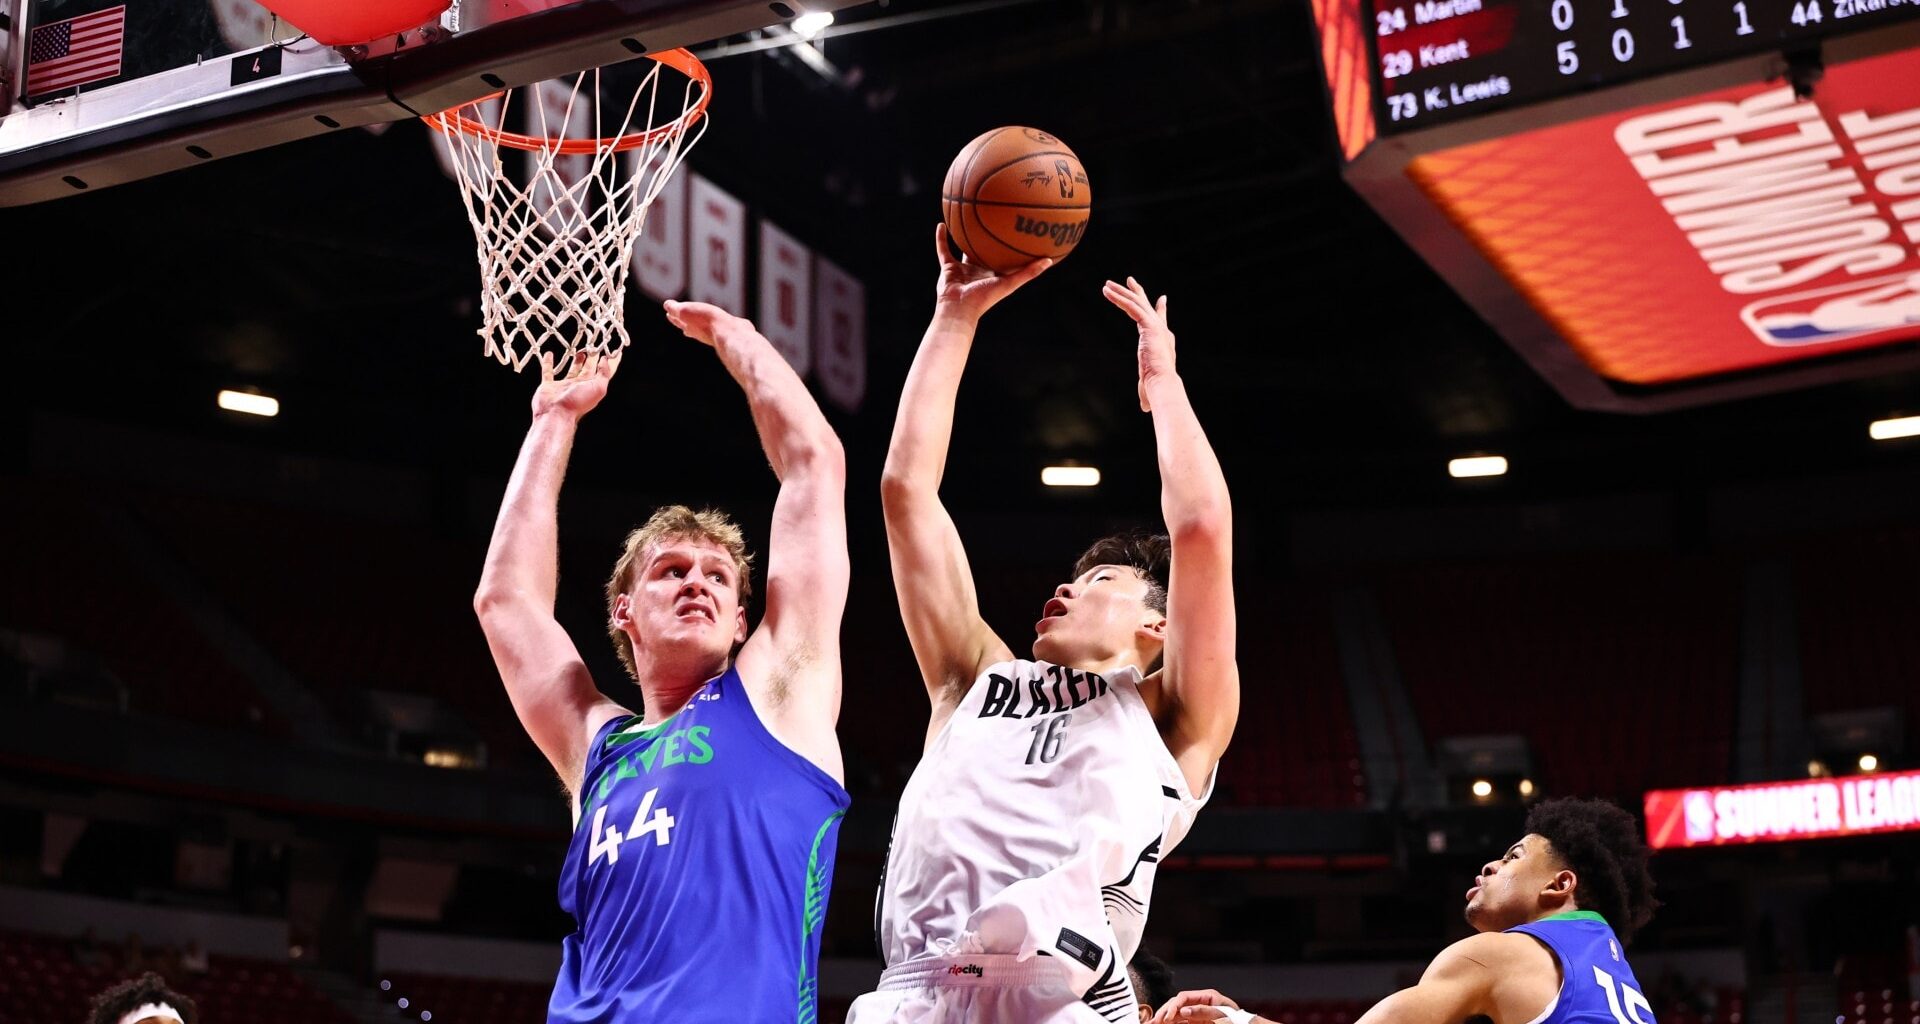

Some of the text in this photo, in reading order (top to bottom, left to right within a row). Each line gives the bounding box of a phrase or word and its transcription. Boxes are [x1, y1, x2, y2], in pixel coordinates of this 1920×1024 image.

[252, 57, 261, 73] 4
[1383, 49, 1413, 78] 29
[1419, 38, 1470, 68] Kent
[1551, 0, 1574, 31] 0
[1386, 92, 1418, 121] 73
[1424, 86, 1449, 111] K.
[1450, 74, 1511, 105] Lewis
[1557, 40, 1579, 75] 5
[1612, 28, 1634, 62] 0
[1671, 15, 1692, 49] 1
[1733, 1, 1754, 35] 1
[1791, 0, 1823, 26] 44
[1613, 85, 1906, 295] SUMMER
[1015, 216, 1088, 247] Wilson
[977, 665, 1108, 719] BLAZER
[1024, 713, 1073, 765] 16
[588, 787, 675, 867] 44
[1715, 783, 1840, 838] SUMMER
